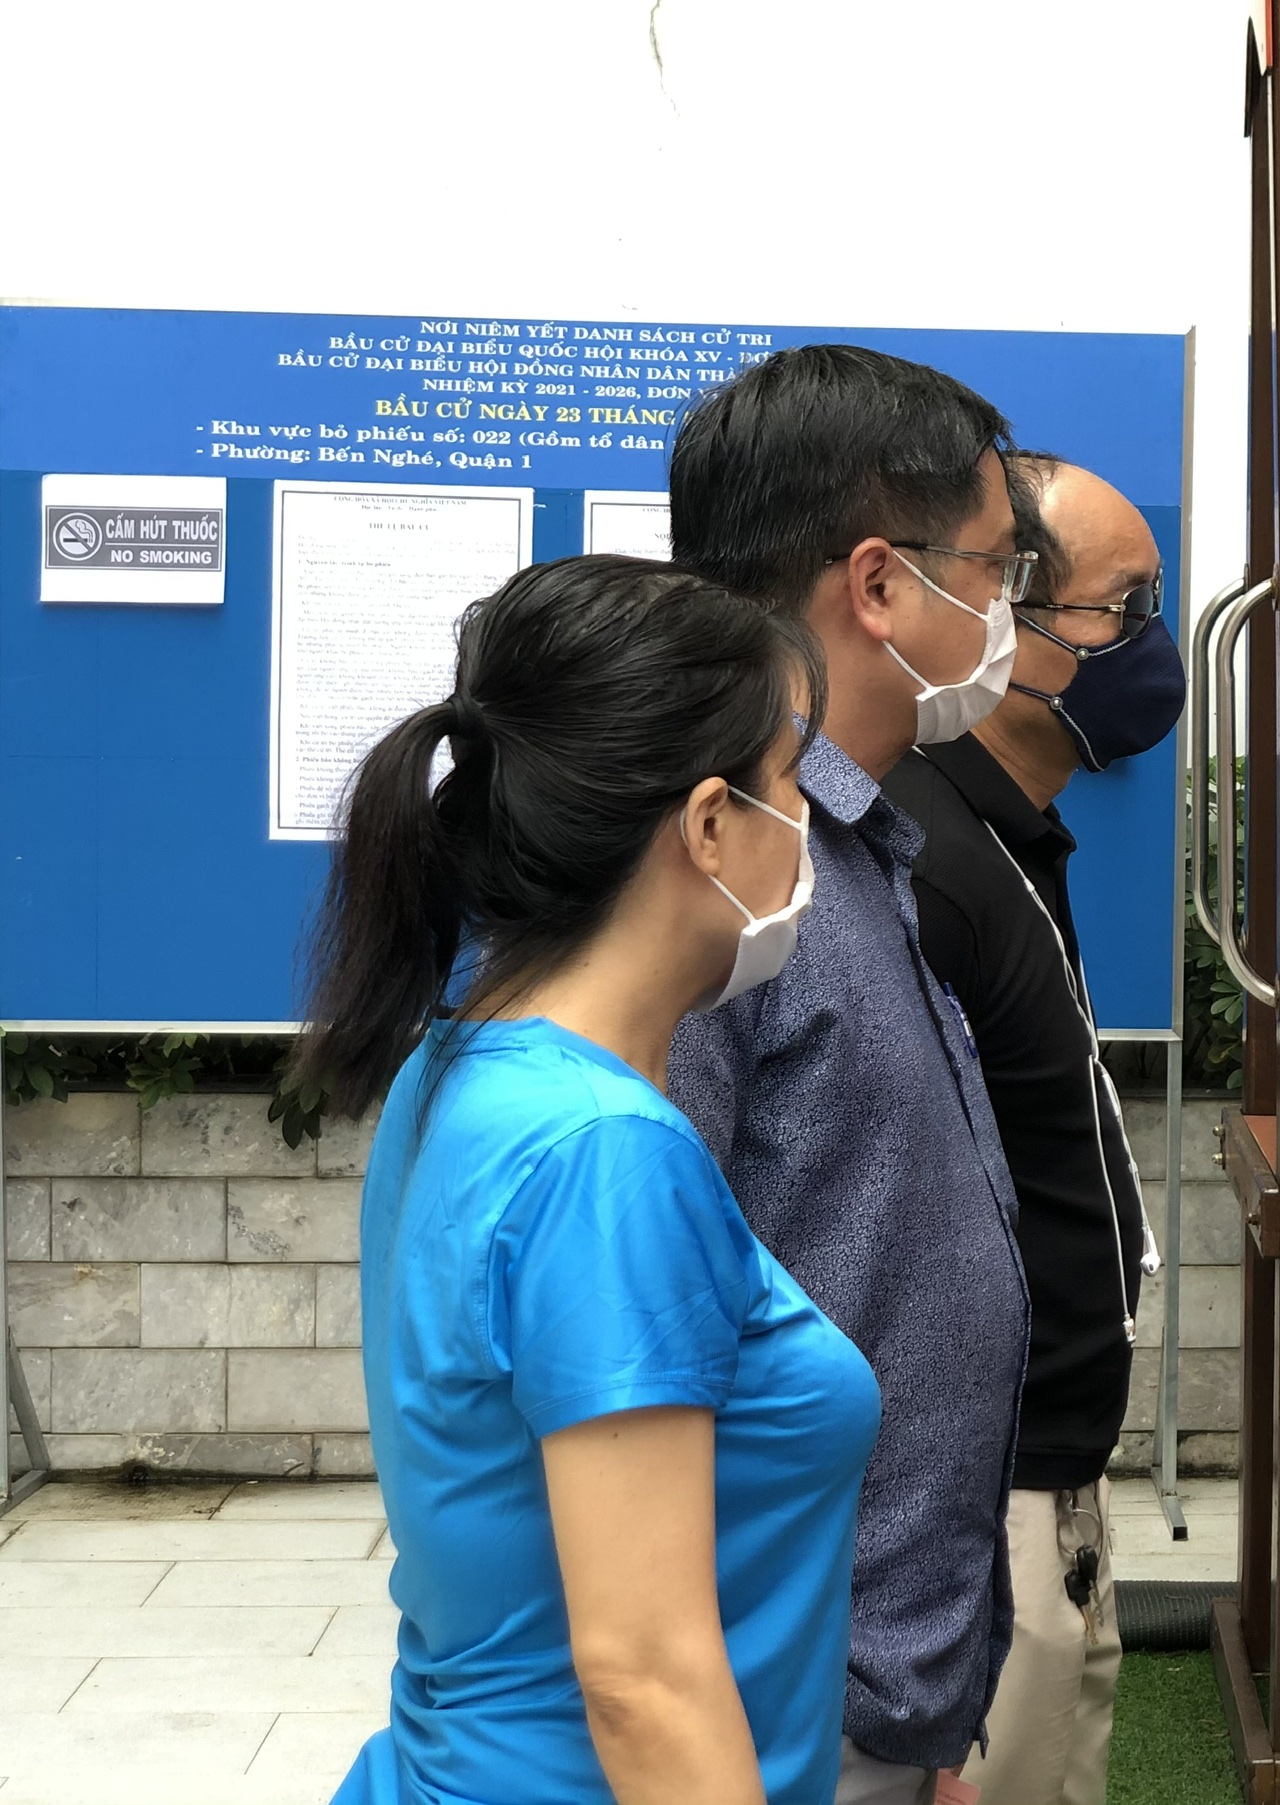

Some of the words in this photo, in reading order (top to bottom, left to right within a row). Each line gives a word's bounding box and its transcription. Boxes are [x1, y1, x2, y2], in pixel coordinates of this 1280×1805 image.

[329, 332, 374, 350] BẦU
[380, 335, 411, 351] CỬ
[416, 340, 455, 356] ĐẠI
[461, 338, 512, 356] BIỂU
[518, 341, 578, 359] QUỐC
[583, 344, 624, 362] HỘI
[629, 346, 689, 363] KHÓA
[693, 350, 722, 363] XV
[420, 321, 459, 335] NƠI
[526, 321, 568, 339] YẾT
[573, 326, 633, 341] DANH
[639, 327, 696, 344] SÁCH
[701, 328, 732, 345] CỬ
[737, 333, 773, 346] TRI
[278, 348, 323, 366] BẦU
[329, 352, 360, 368] CỬ
[365, 357, 404, 372] ĐẠI
[410, 355, 462, 372] BIỂU
[468, 359, 508, 377] HỘI
[513, 359, 573, 377] ĐỒNG
[580, 361, 640, 379] NHÂN
[646, 364, 691, 381] DÂN
[696, 367, 737, 382] THÀ
[422, 376, 500, 394] NHIỆM
[500, 377, 530, 394] KỲ
[535, 383, 576, 396] 2021
[594, 385, 641, 400] 2026,
[646, 385, 692, 400] ĐƠN
[375, 393, 429, 418] BẦU
[436, 396, 472, 419] CỬ
[478, 399, 549, 422] NGÀY
[555, 406, 582, 423] 23
[588, 404, 676, 426] THÁNG
[211, 420, 261, 437] Khu
[268, 424, 312, 440] vực
[319, 424, 348, 439] bỏ
[356, 425, 425, 443] phiếu
[432, 427, 466, 444] số:
[472, 430, 511, 445] 022
[518, 429, 582, 448] (Gồm
[589, 432, 614, 449] tổ
[620, 434, 665, 450] dân
[211, 443, 311, 464] Phường:
[317, 446, 366, 463] Bến
[372, 448, 442, 468] Nghé,
[449, 451, 513, 469] Quận
[521, 454, 532, 469] 1
[105, 512, 135, 540] CẤM
[139, 514, 168, 540] HÚT
[172, 514, 218, 542] THUỐC
[110, 549, 134, 563] NO
[139, 550, 213, 565] SMOKING
